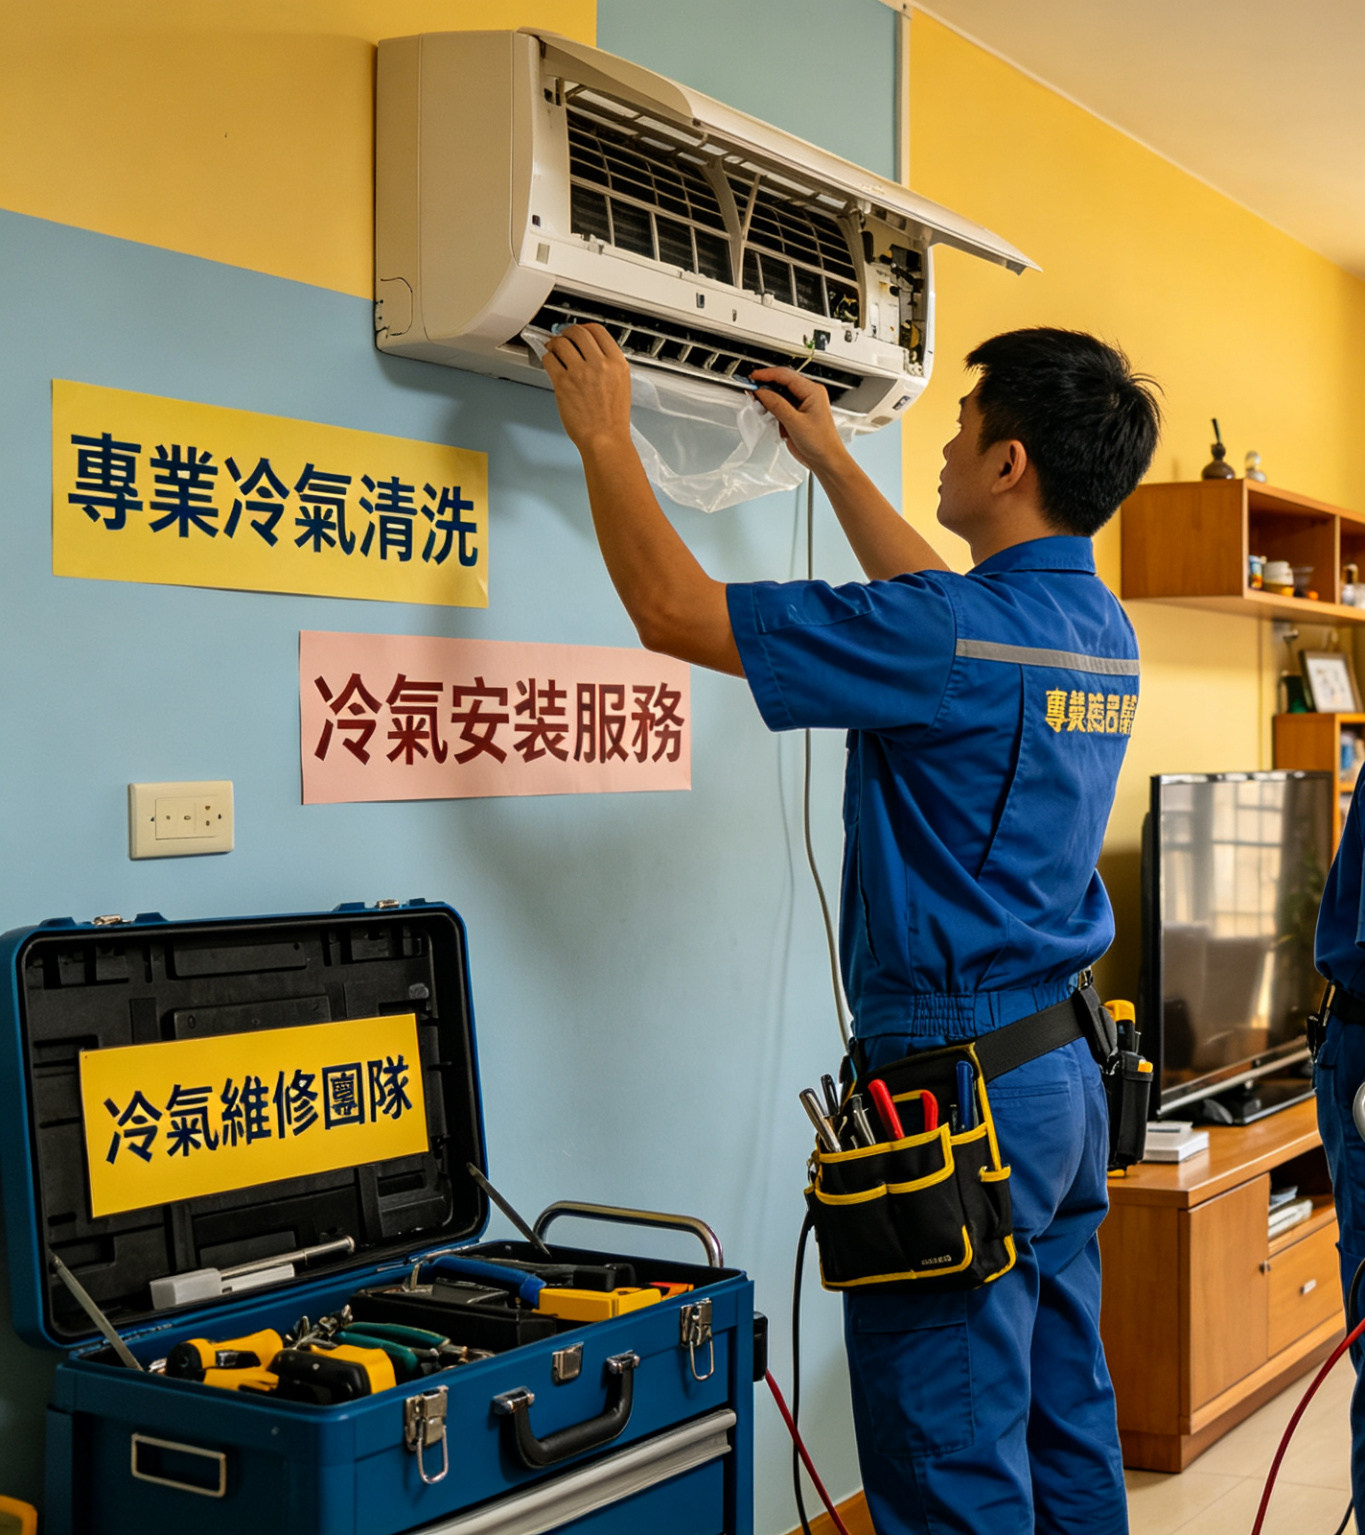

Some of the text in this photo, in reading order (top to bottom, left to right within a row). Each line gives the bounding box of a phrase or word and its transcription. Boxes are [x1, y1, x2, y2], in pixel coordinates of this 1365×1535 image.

[68, 432, 478, 567] 專業冷氣清洗
[103, 1055, 413, 1164] 冷氣維修團隊
